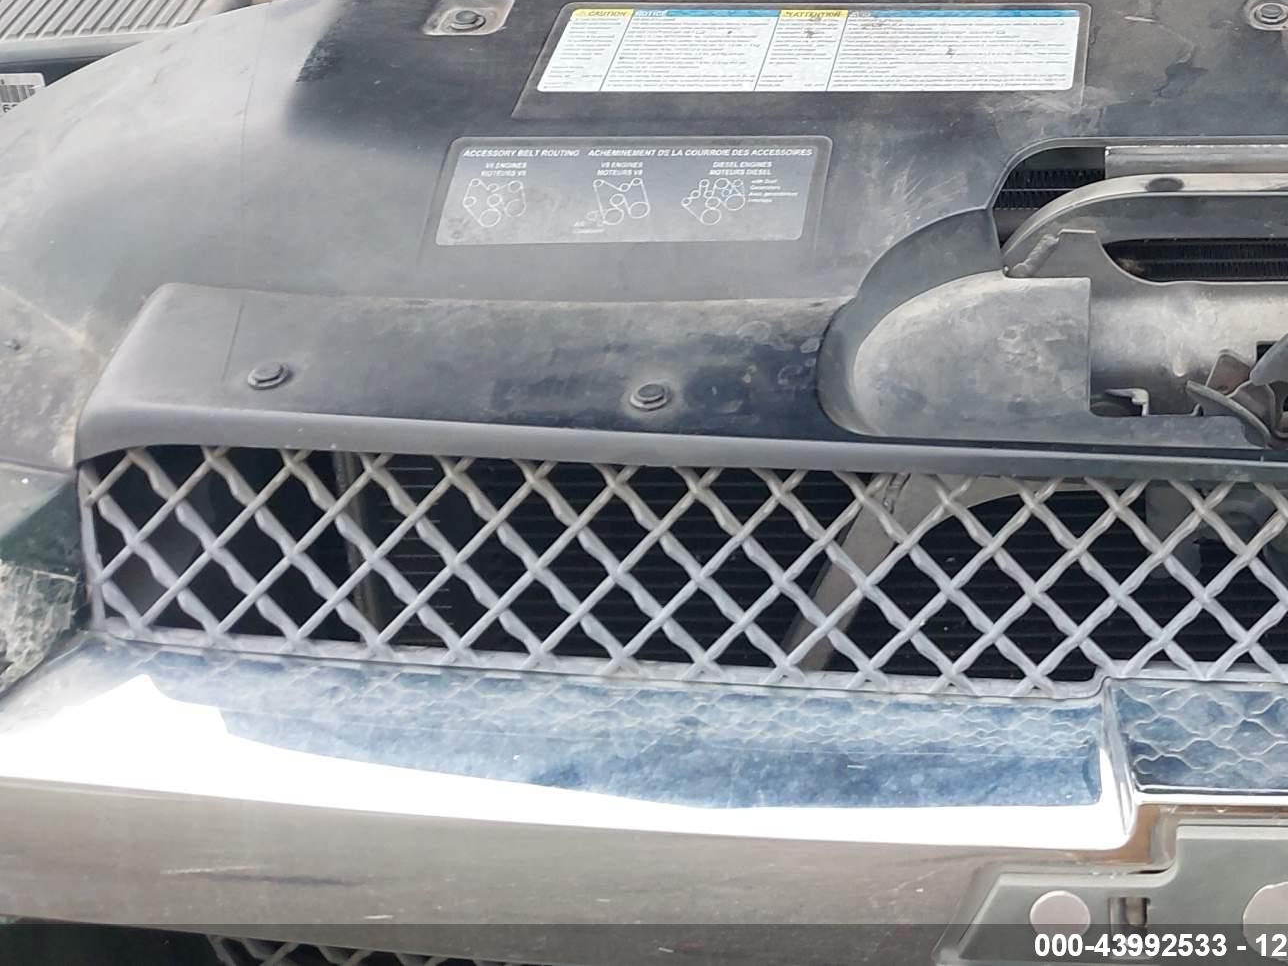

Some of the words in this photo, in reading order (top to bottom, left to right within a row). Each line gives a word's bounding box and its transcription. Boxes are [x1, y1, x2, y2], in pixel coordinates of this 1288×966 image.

[463, 149, 515, 157] ACCESSORY
[517, 149, 540, 157] BELT
[541, 149, 580, 157] ROUTING
